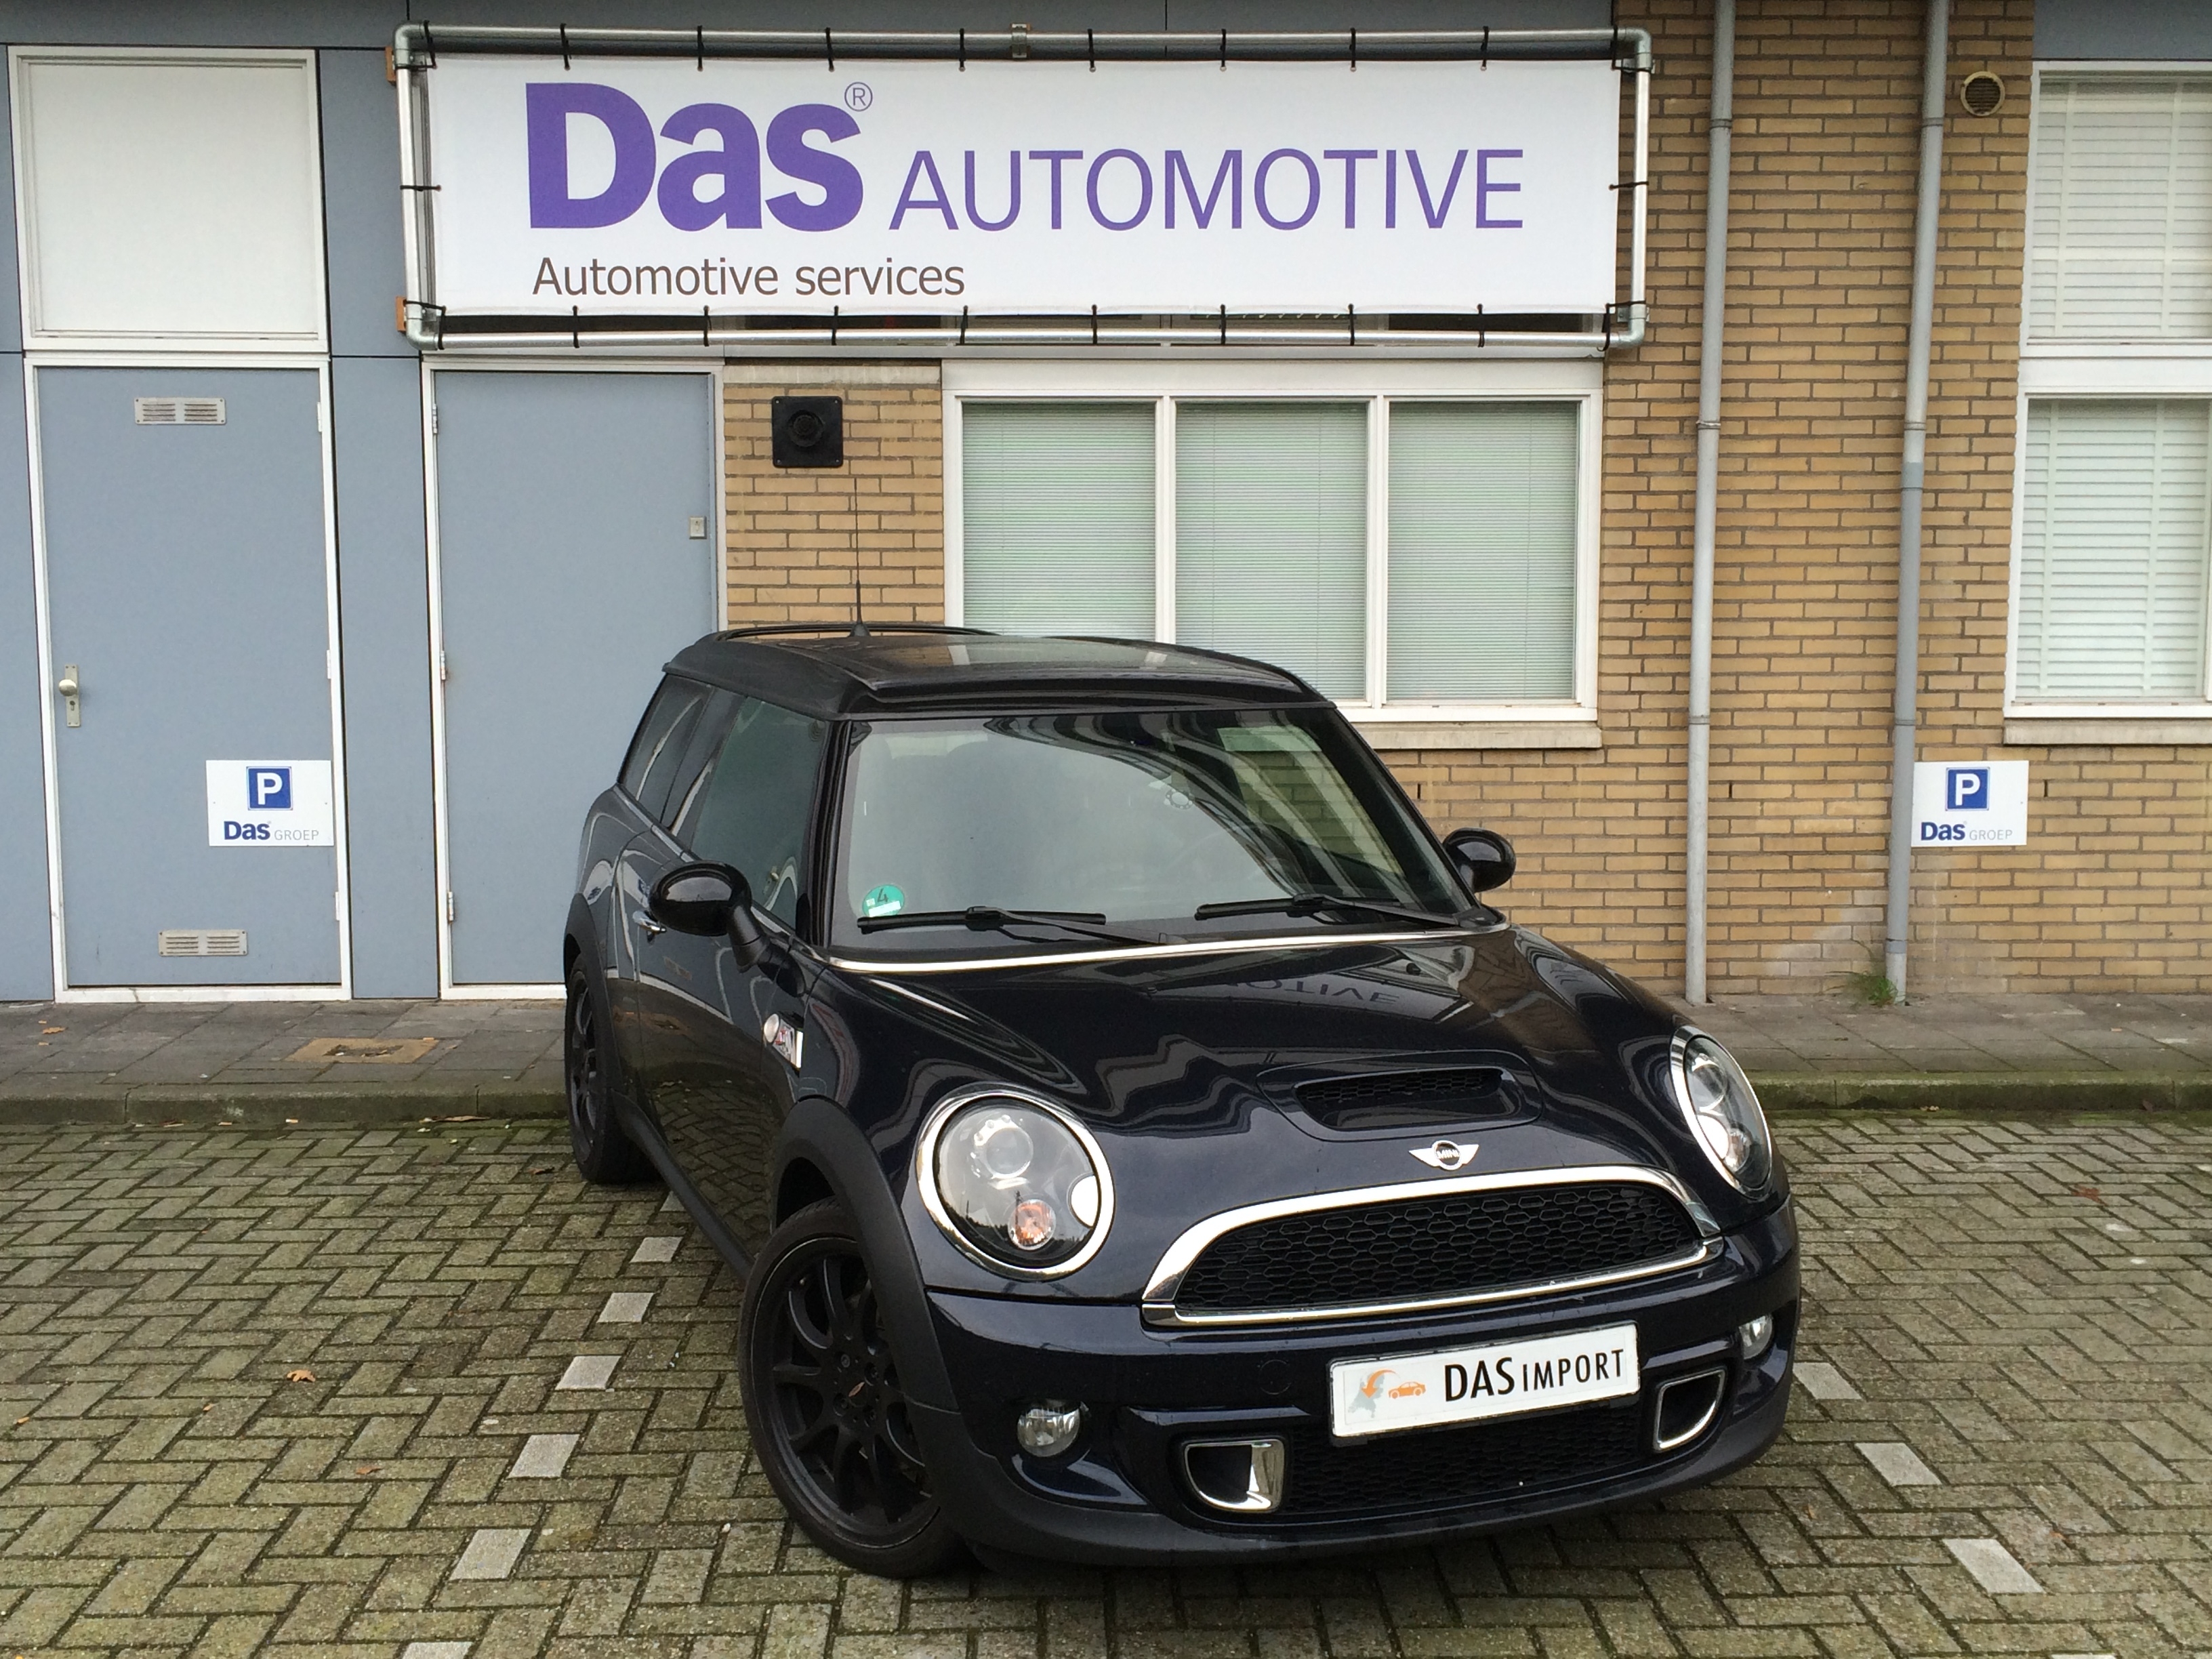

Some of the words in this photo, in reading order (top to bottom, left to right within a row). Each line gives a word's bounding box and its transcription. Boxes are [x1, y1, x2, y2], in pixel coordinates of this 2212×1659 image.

[888, 147, 1523, 231] AUTOMOTIVE
[533, 257, 778, 296] Automotive
[795, 258, 965, 296] services
[257, 773, 283, 805] P
[1955, 773, 1980, 806] P
[224, 821, 270, 840] Das
[274, 830, 319, 840] GROEP
[1921, 821, 1965, 841] Das
[1969, 830, 2013, 841] GROEP
[1445, 1357, 1515, 1402] DAS
[1523, 1349, 1624, 1391] IMPORT
